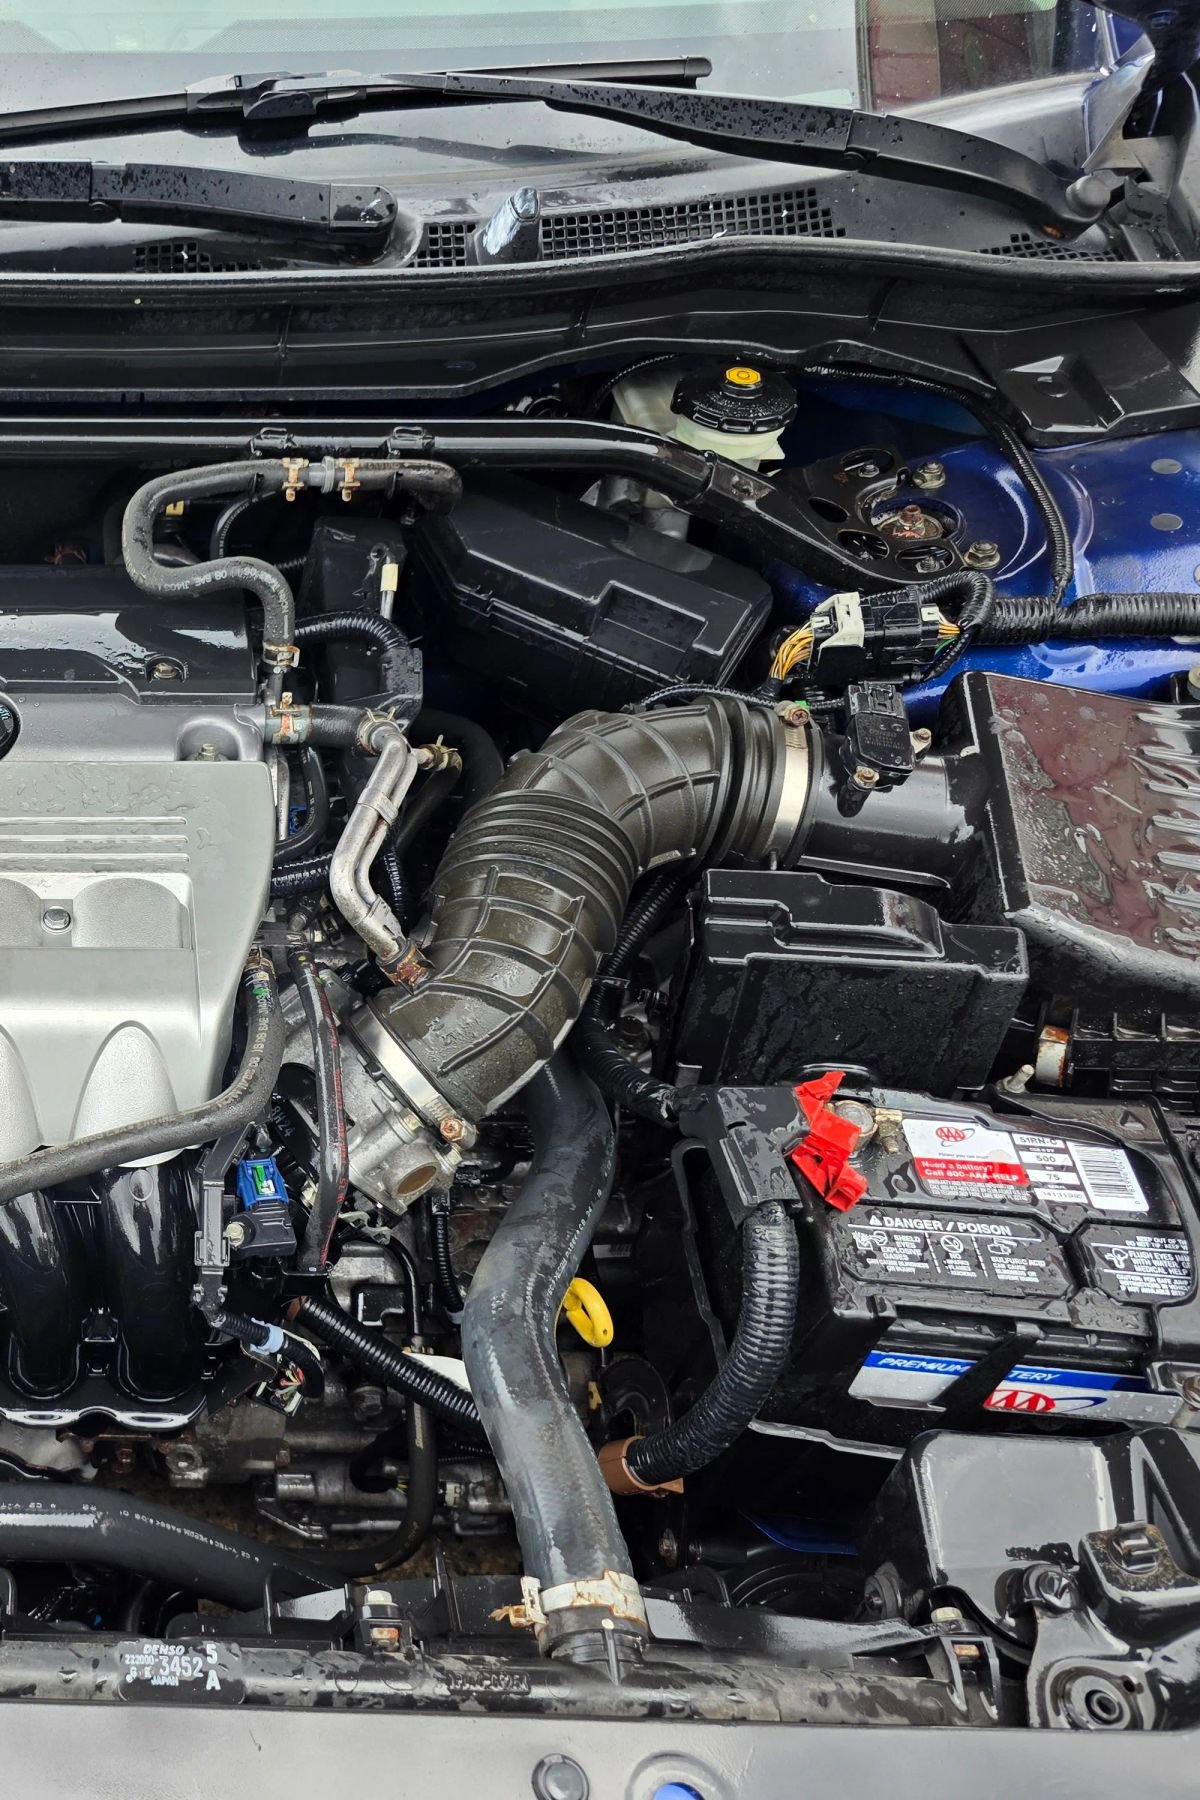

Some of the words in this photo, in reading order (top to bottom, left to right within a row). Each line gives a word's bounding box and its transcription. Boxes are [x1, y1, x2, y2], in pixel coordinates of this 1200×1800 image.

[935, 1126, 967, 1142] AAA
[1019, 1137, 1058, 1145] 51RN-C
[1035, 1155, 1056, 1163] 500
[957, 1162, 993, 1173] battery?
[924, 1168, 945, 1177] Call
[946, 1170, 1019, 1181] 800-AAA-HELP
[1046, 1173, 1060, 1181] 75
[883, 1216, 943, 1231] DANGER
[958, 1222, 1013, 1235] POISON
[1128, 1250, 1153, 1259] FLUSH
[1154, 1252, 1175, 1261] EYES
[1134, 1264, 1168, 1274] MEDICAL
[877, 1356, 972, 1374] PREMIUM
[1007, 1369, 1062, 1382] TERY
[143, 1643, 187, 1656] DENSO
[206, 1643, 218, 1665] 5
[151, 1675, 180, 1687] JAPAN
[205, 1669, 221, 1691] A
